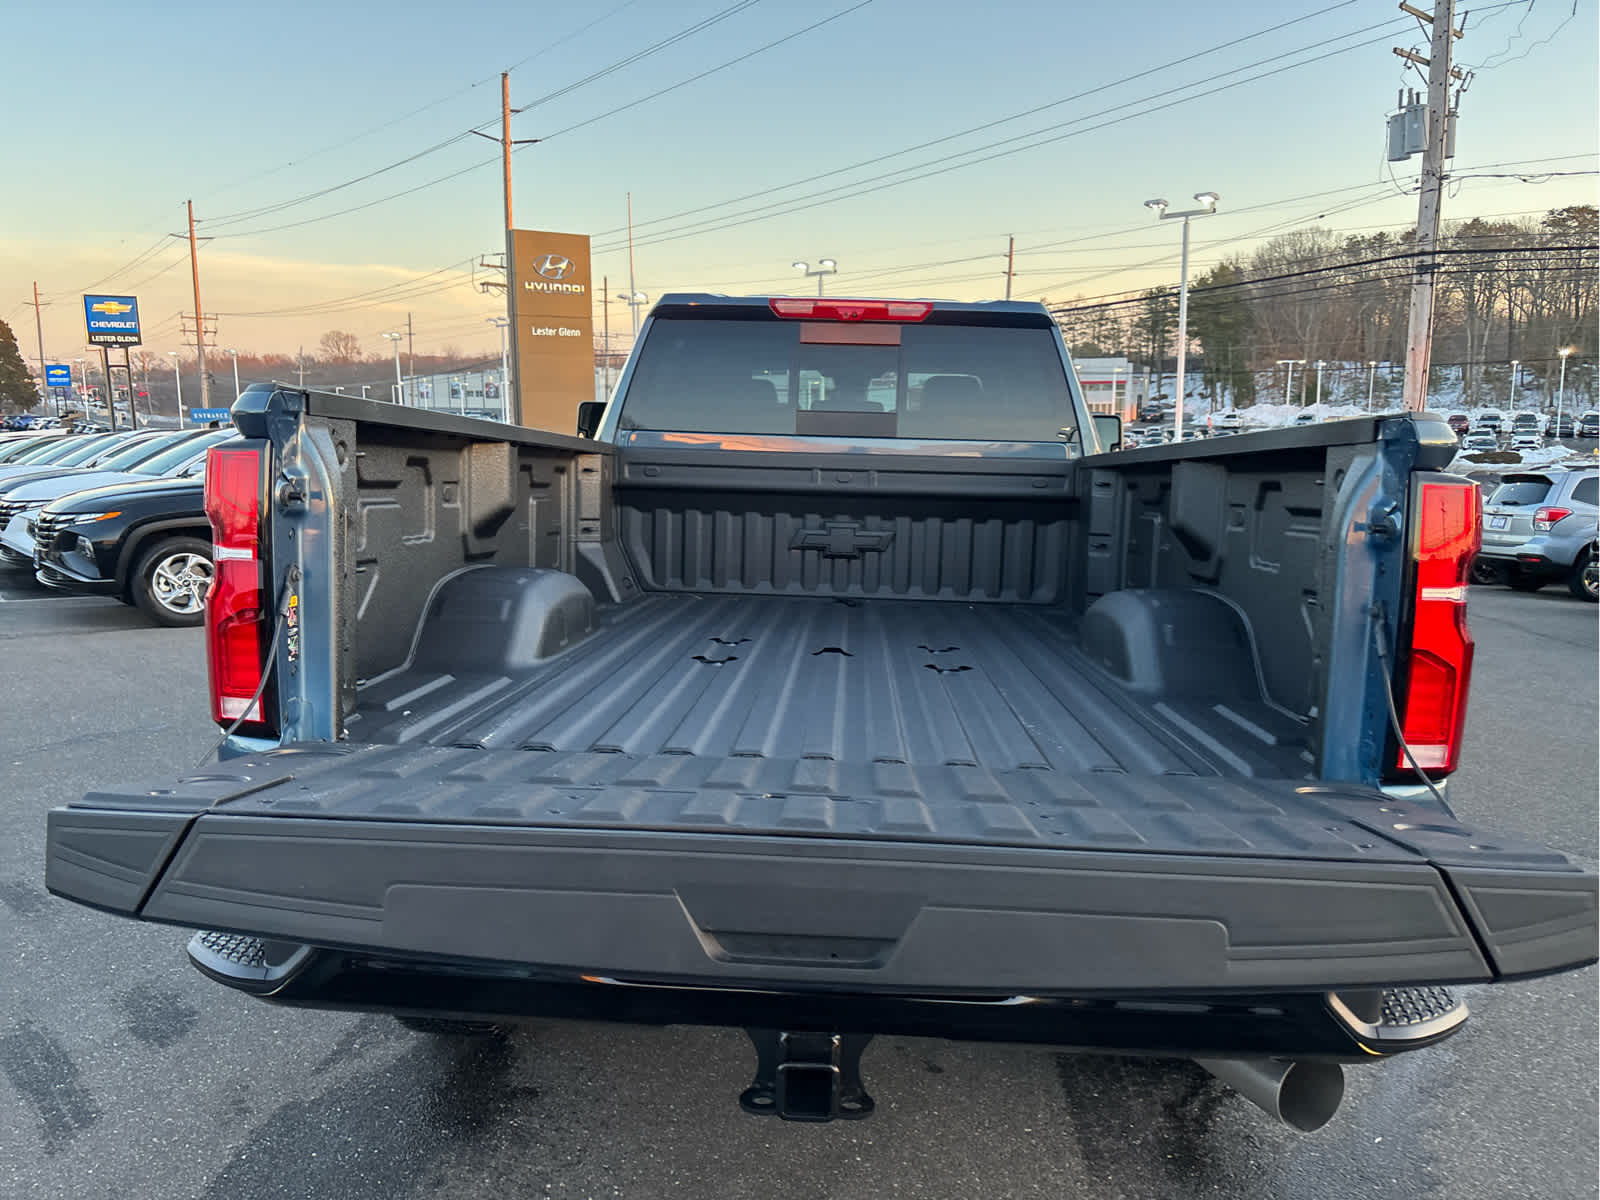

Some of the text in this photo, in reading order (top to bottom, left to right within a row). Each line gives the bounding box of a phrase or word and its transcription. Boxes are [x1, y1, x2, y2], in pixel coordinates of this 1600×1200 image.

[524, 281, 585, 293] HYUNDAI
[90, 320, 137, 329] CHEVROLET
[531, 327, 581, 337] Lester Glenn
[117, 335, 139, 343] GLENN
